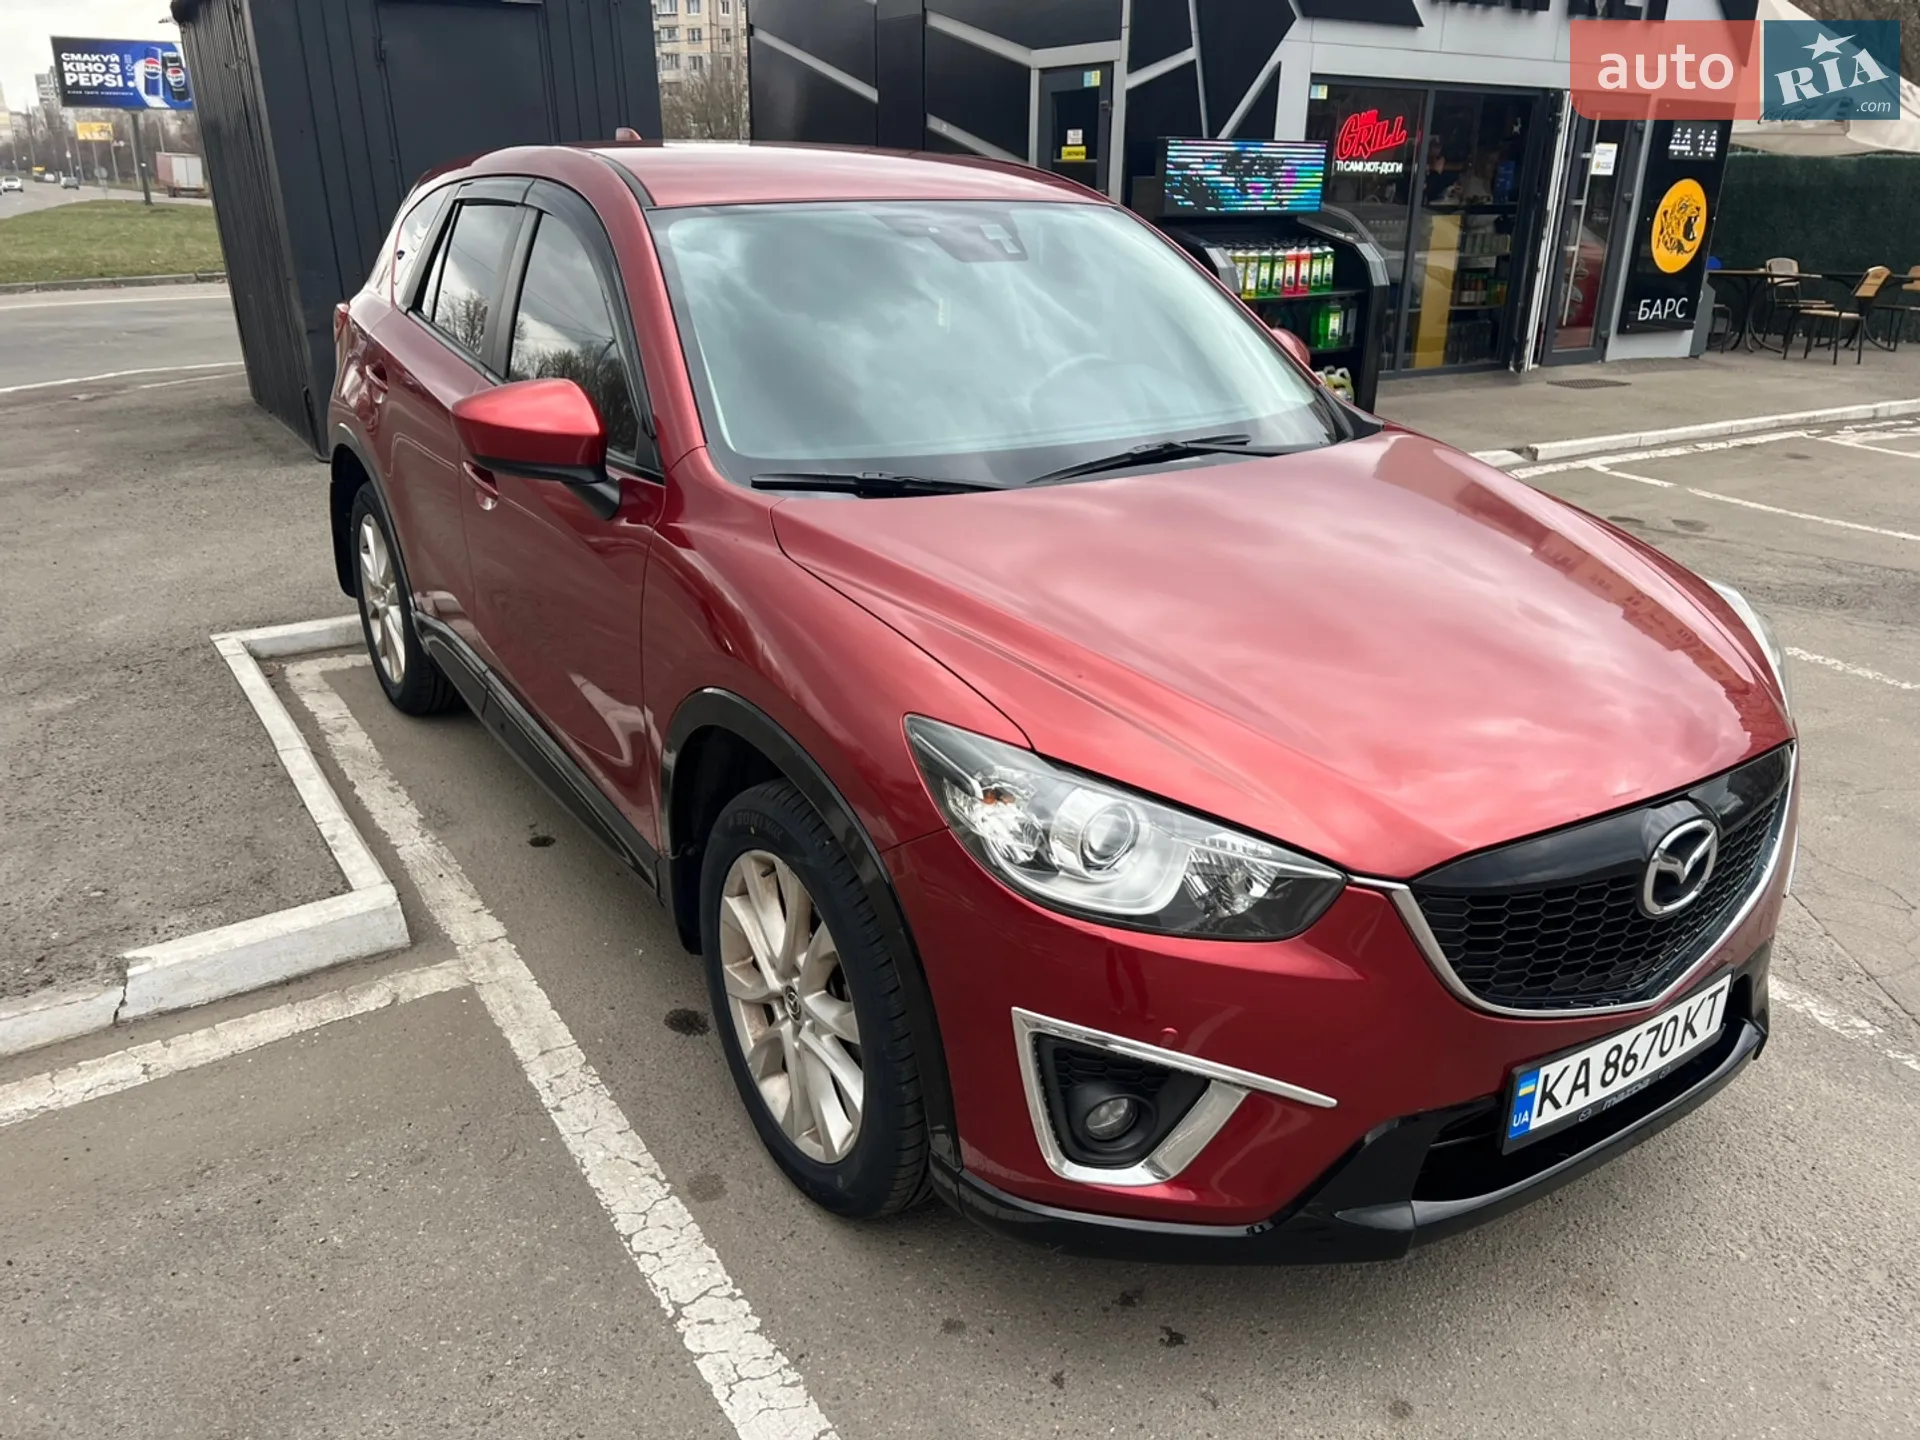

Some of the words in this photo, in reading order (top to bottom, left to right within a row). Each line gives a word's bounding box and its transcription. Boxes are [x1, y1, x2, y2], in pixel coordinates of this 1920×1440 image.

[61, 53, 120, 62] СМАКУЙ
[62, 62, 106, 72] КІНО
[64, 73, 124, 88] PEPSI
[1337, 113, 1407, 160] GRILL
[1364, 160, 1403, 174] ХОТ-ДОГИ
[1637, 297, 1688, 322] БАРС
[1600, 1014, 1679, 1089] 8670
[1512, 1110, 1530, 1128] UA
